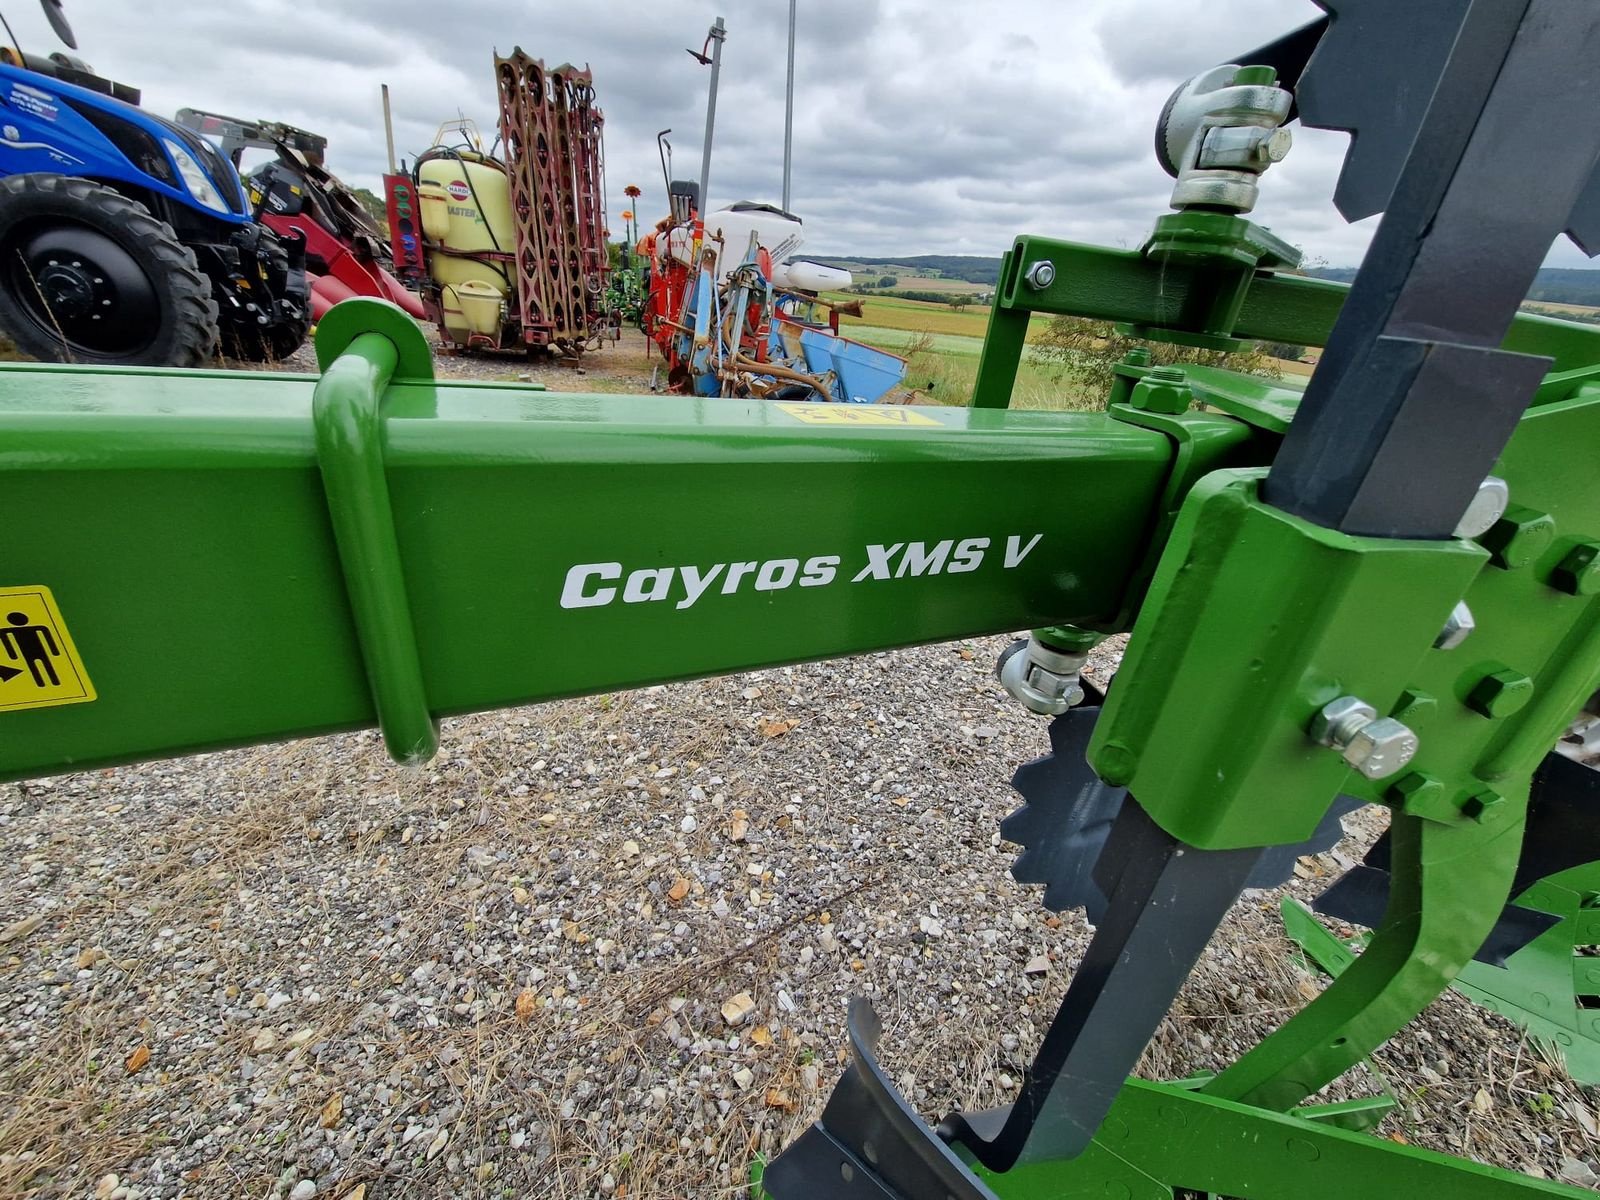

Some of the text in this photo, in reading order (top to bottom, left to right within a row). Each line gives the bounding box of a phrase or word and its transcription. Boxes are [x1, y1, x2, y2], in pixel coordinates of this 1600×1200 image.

[449, 186, 469, 194] HARDI
[560, 533, 1044, 610] Cayros XMS V
